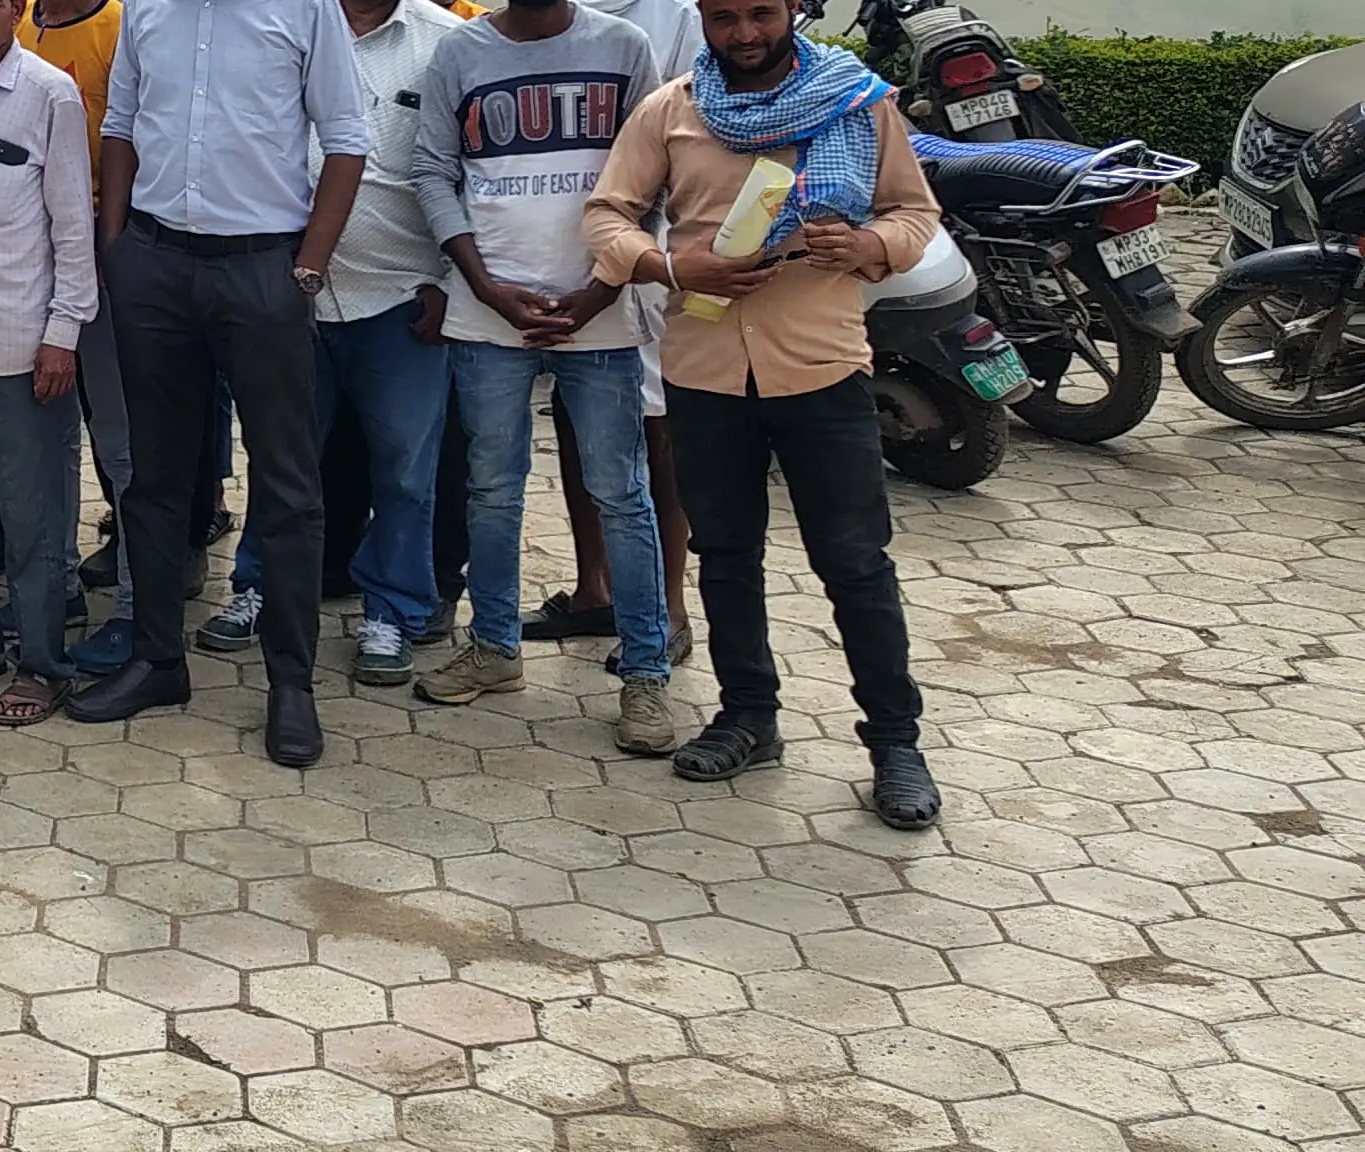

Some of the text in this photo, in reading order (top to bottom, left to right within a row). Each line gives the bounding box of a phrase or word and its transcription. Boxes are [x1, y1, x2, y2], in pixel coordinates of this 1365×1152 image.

[532, 174, 548, 196] OF
[550, 172, 579, 194] EAST
[1113, 229, 1150, 254] MP33
